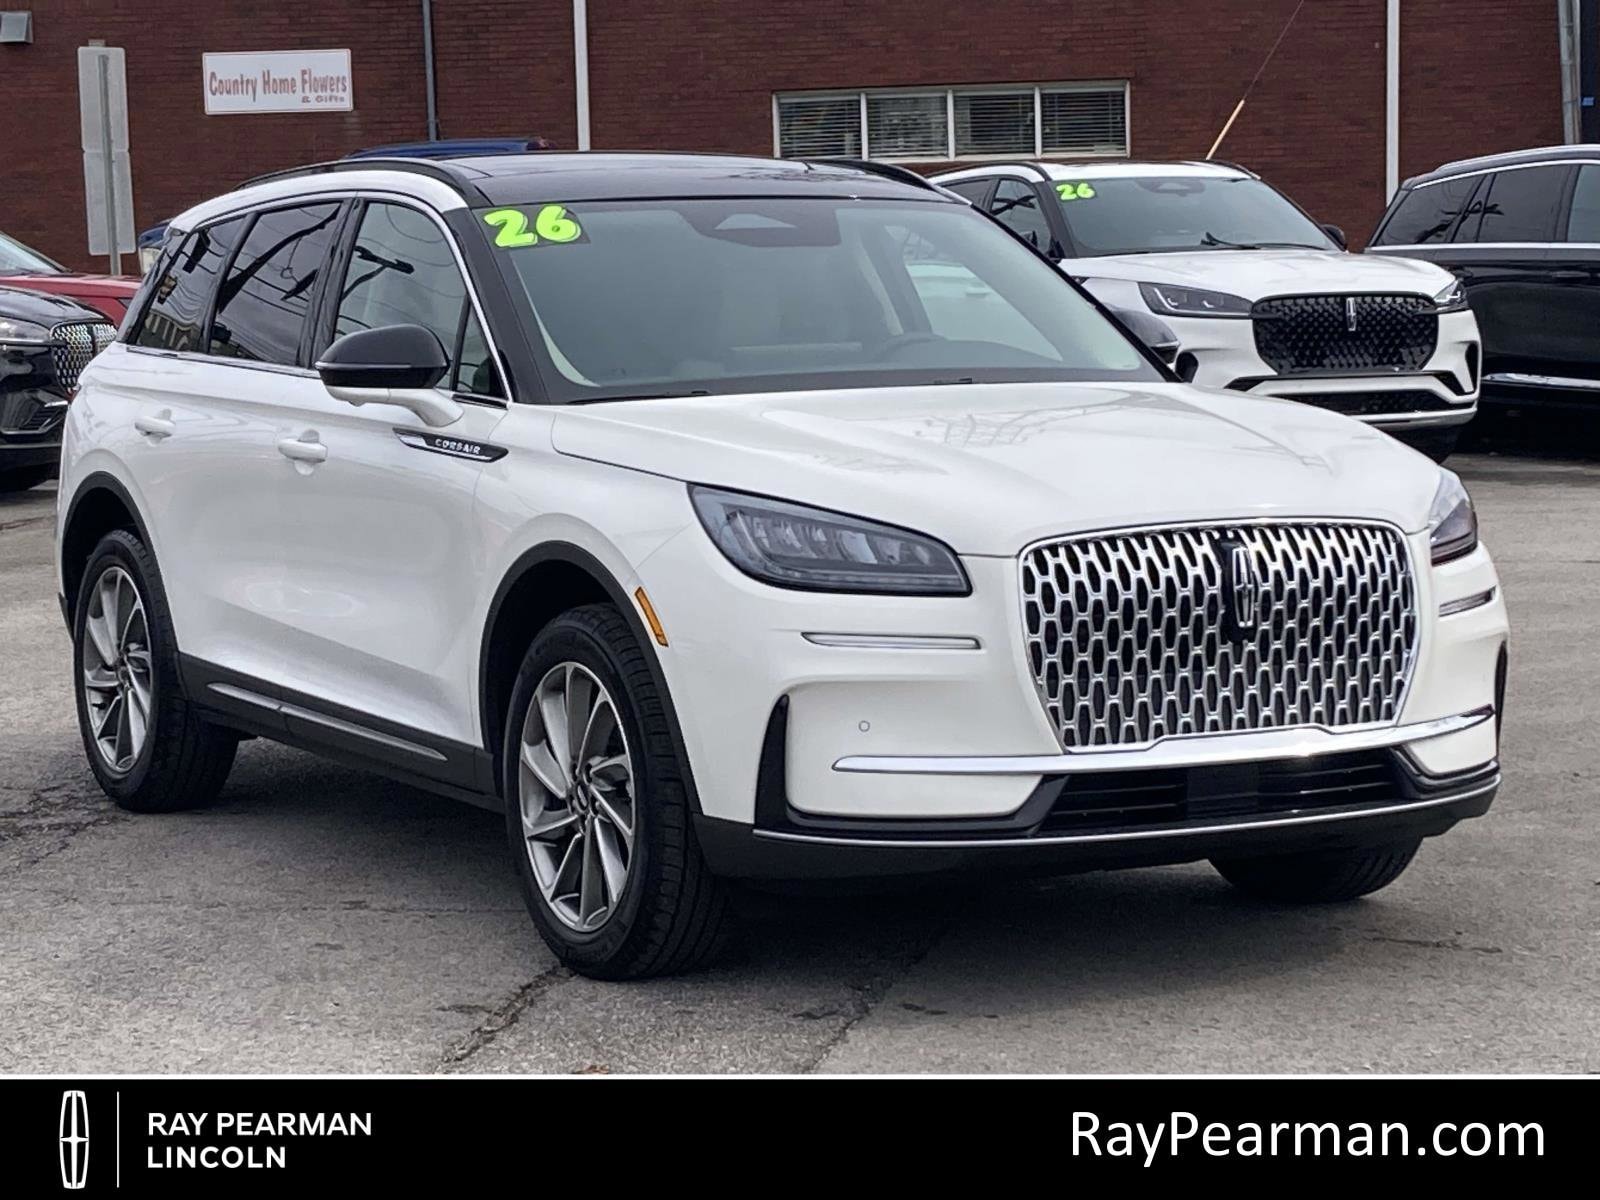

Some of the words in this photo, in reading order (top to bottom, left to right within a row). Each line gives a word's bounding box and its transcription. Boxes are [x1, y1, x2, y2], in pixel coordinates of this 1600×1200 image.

[209, 71, 257, 102] Country
[262, 69, 297, 94] Home
[301, 68, 347, 93] Flowers
[1056, 182, 1096, 200] 26
[484, 204, 581, 247] 26
[435, 438, 480, 454] CORSAIR
